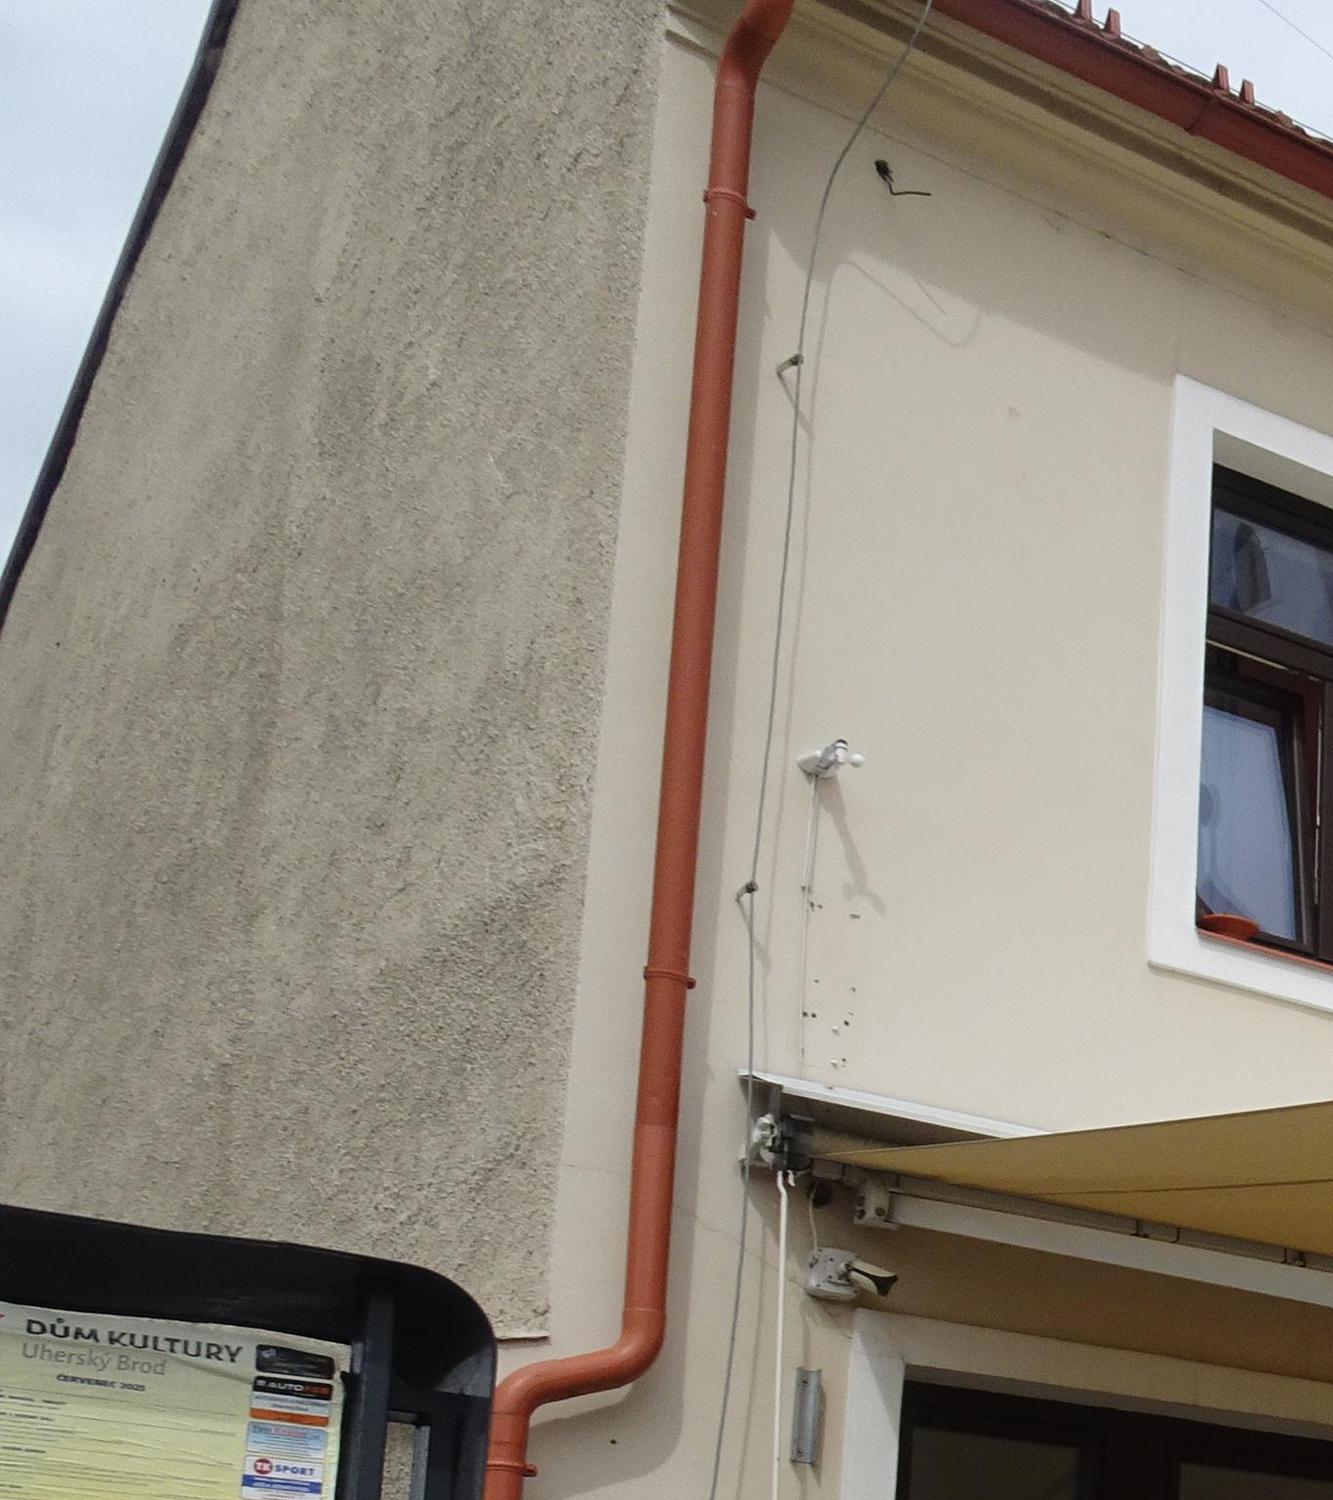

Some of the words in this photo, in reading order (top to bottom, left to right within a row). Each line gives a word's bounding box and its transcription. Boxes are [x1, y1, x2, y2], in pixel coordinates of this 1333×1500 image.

[26, 1317, 100, 1343] DŮM
[108, 1331, 244, 1363] KULTURY
[22, 1342, 111, 1371] Uherský
[116, 1354, 167, 1375] Brod
[275, 1464, 315, 1476] SPORT
